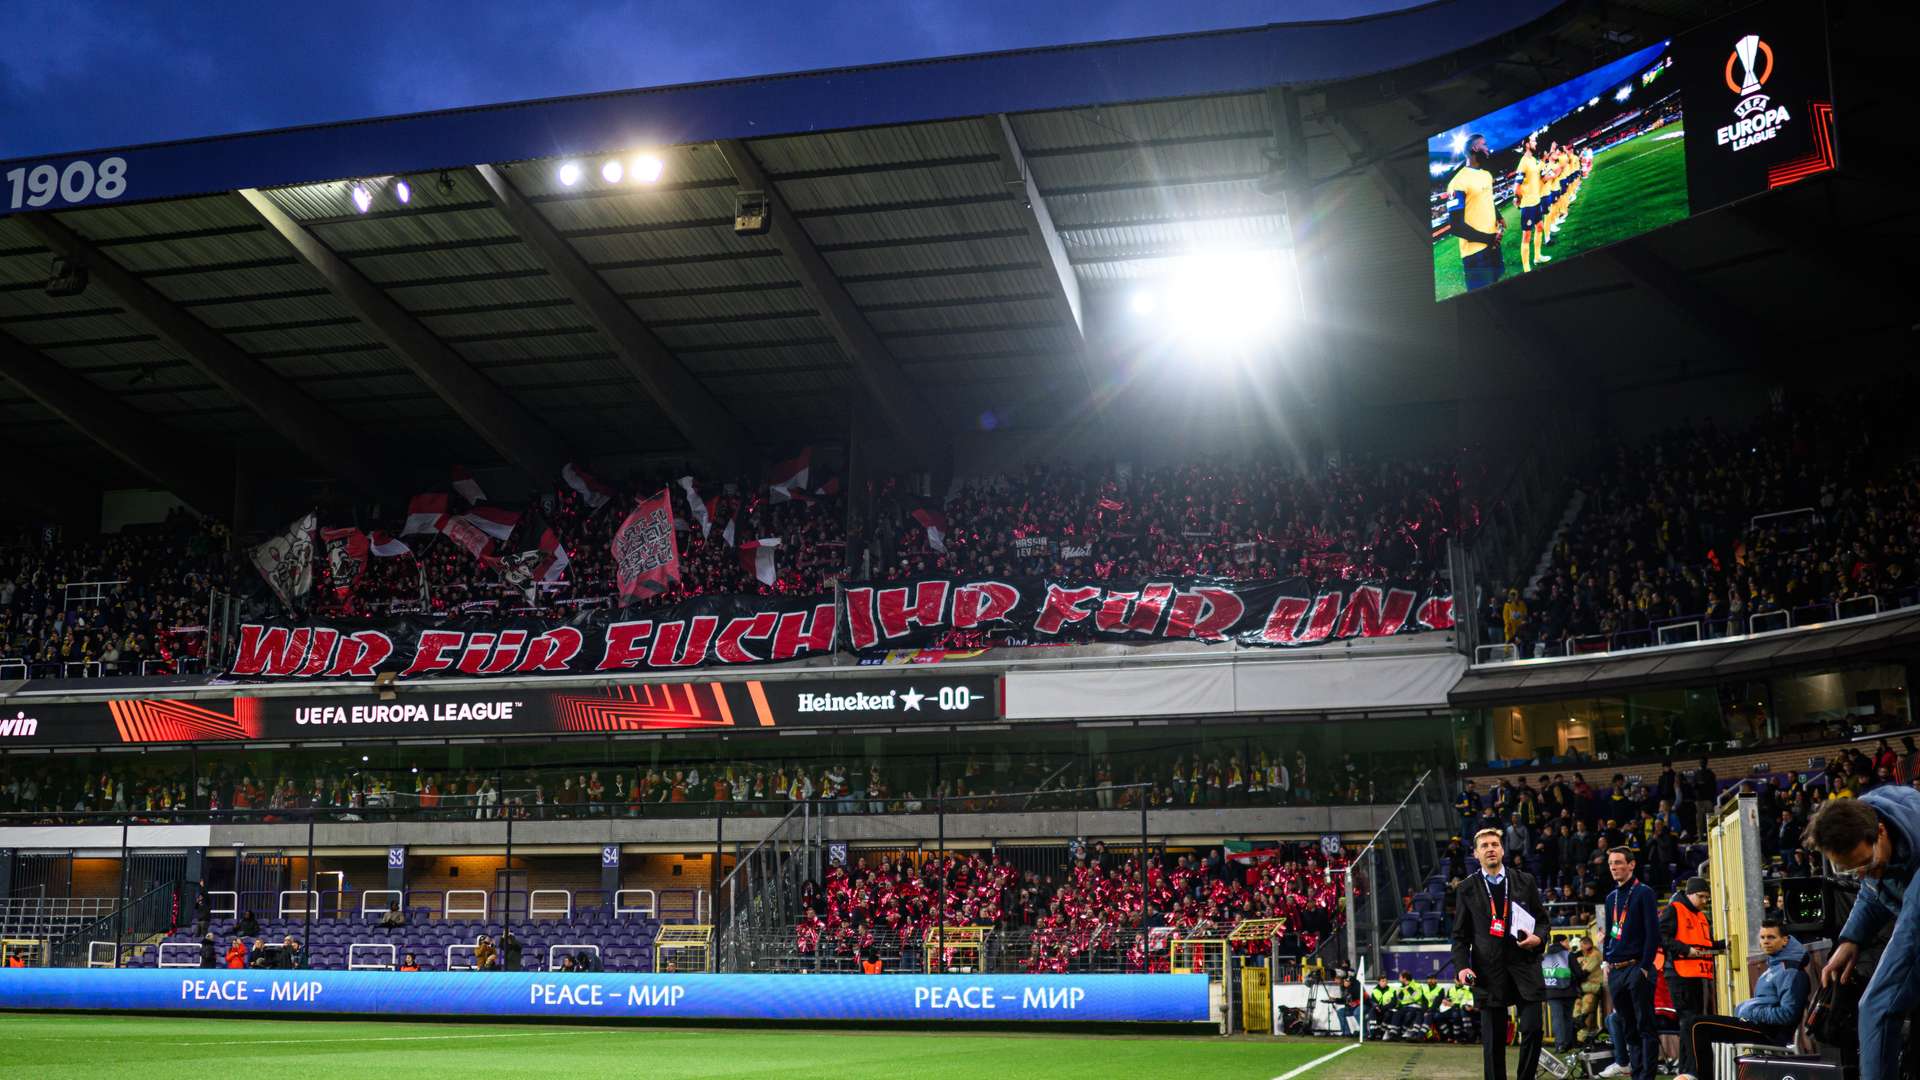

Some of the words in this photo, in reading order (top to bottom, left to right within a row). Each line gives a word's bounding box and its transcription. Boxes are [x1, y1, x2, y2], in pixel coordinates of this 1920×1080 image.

[1735, 98, 1767, 116] UEFA
[1717, 105, 1790, 145] EUROPA
[6, 157, 127, 208] 1908
[845, 581, 1020, 650] IHR
[231, 624, 393, 677] WIR
[400, 627, 582, 676] FÜR
[595, 604, 836, 670] EUCH
[798, 691, 895, 712] Heineken
[295, 707, 347, 725] UEFA
[352, 704, 429, 724] EUROPA
[389, 849, 403, 865] S3
[603, 848, 618, 863] S4
[830, 845, 845, 860] S5
[1544, 968, 1557, 977] TV
[181, 979, 248, 1000] PEACE
[270, 981, 323, 1001] МИР
[530, 984, 604, 1005] PEACE
[628, 985, 685, 1006] МИР
[914, 986, 996, 1008] PEACE
[1023, 987, 1085, 1009] МИР
